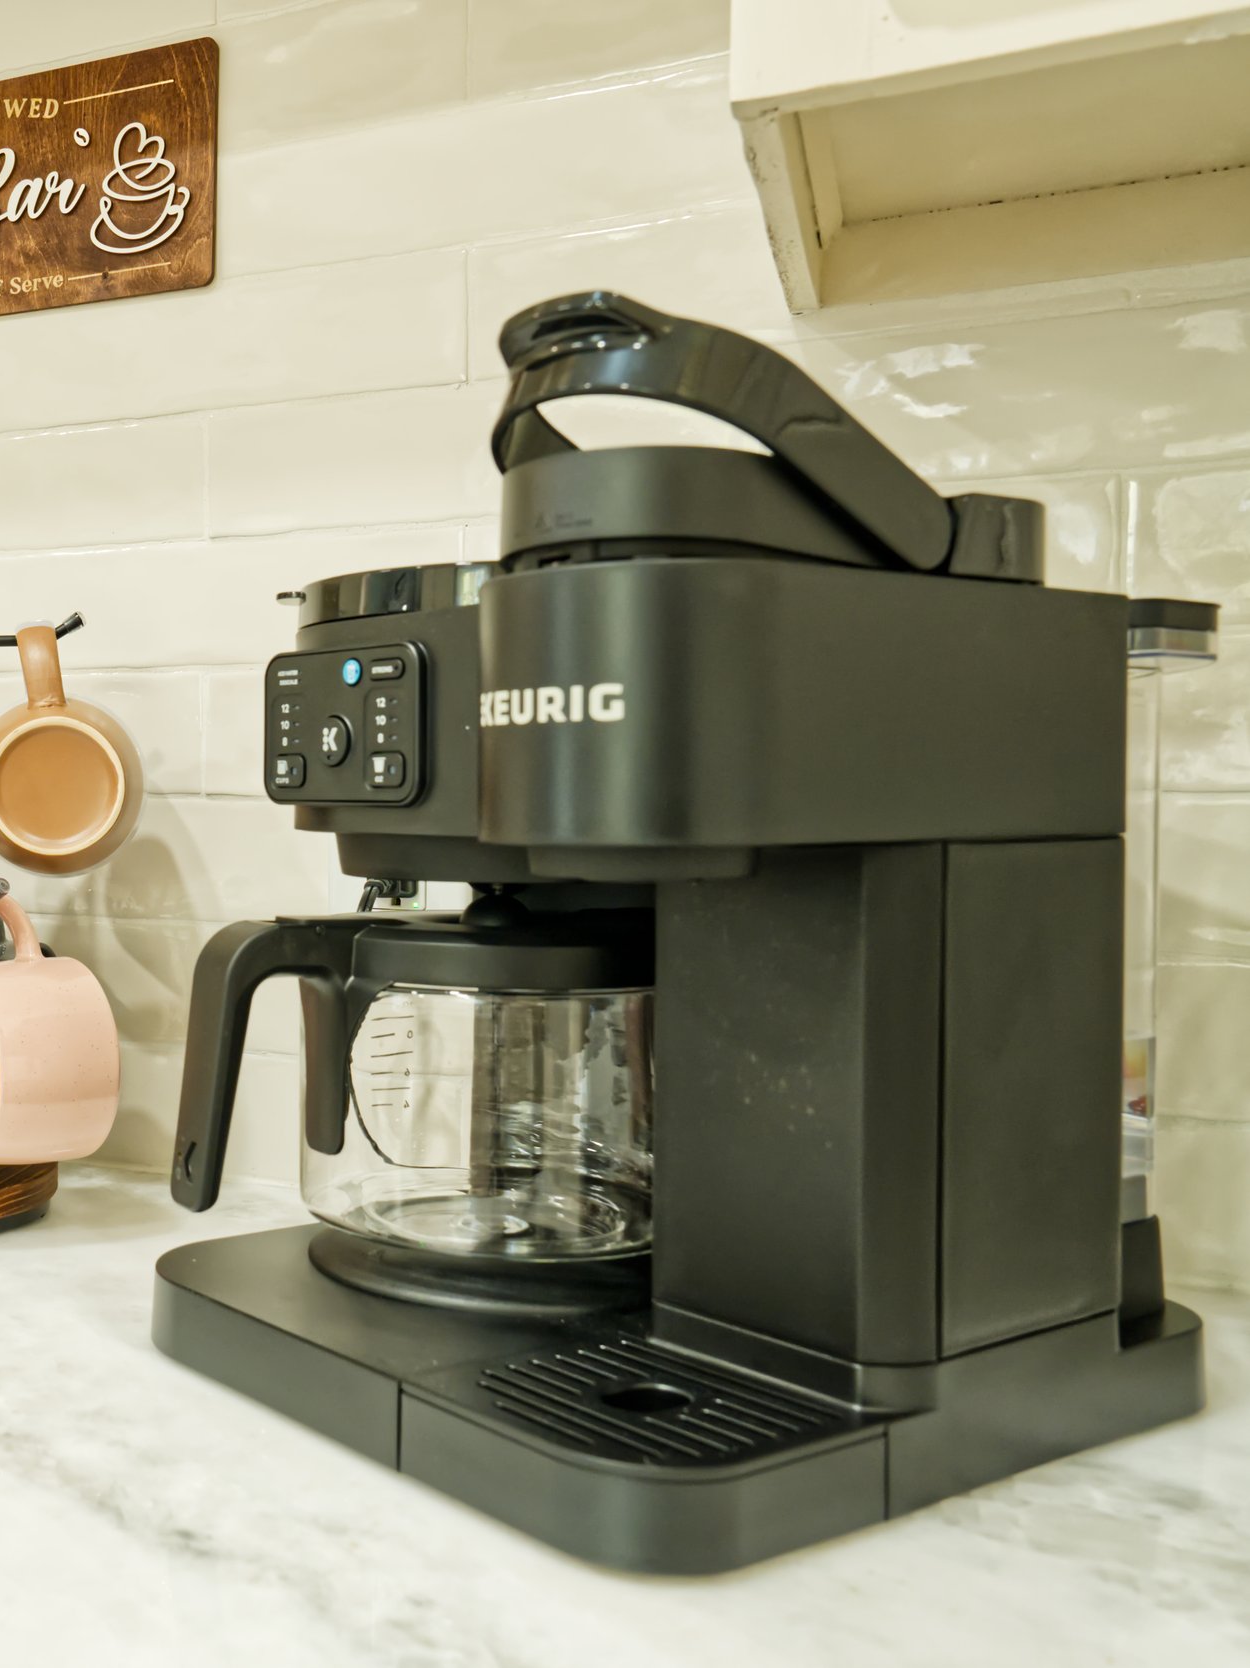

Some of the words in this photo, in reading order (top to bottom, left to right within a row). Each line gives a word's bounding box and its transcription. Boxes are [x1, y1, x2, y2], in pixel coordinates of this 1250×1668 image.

[9, 271, 64, 294] Serve
[376, 697, 386, 708] 12
[480, 682, 626, 728] KEURIG
[281, 704, 290, 713] 12
[280, 720, 290, 730] 10
[375, 715, 387, 726] 10
[282, 737, 288, 747] 8
[377, 733, 384, 744] 8
